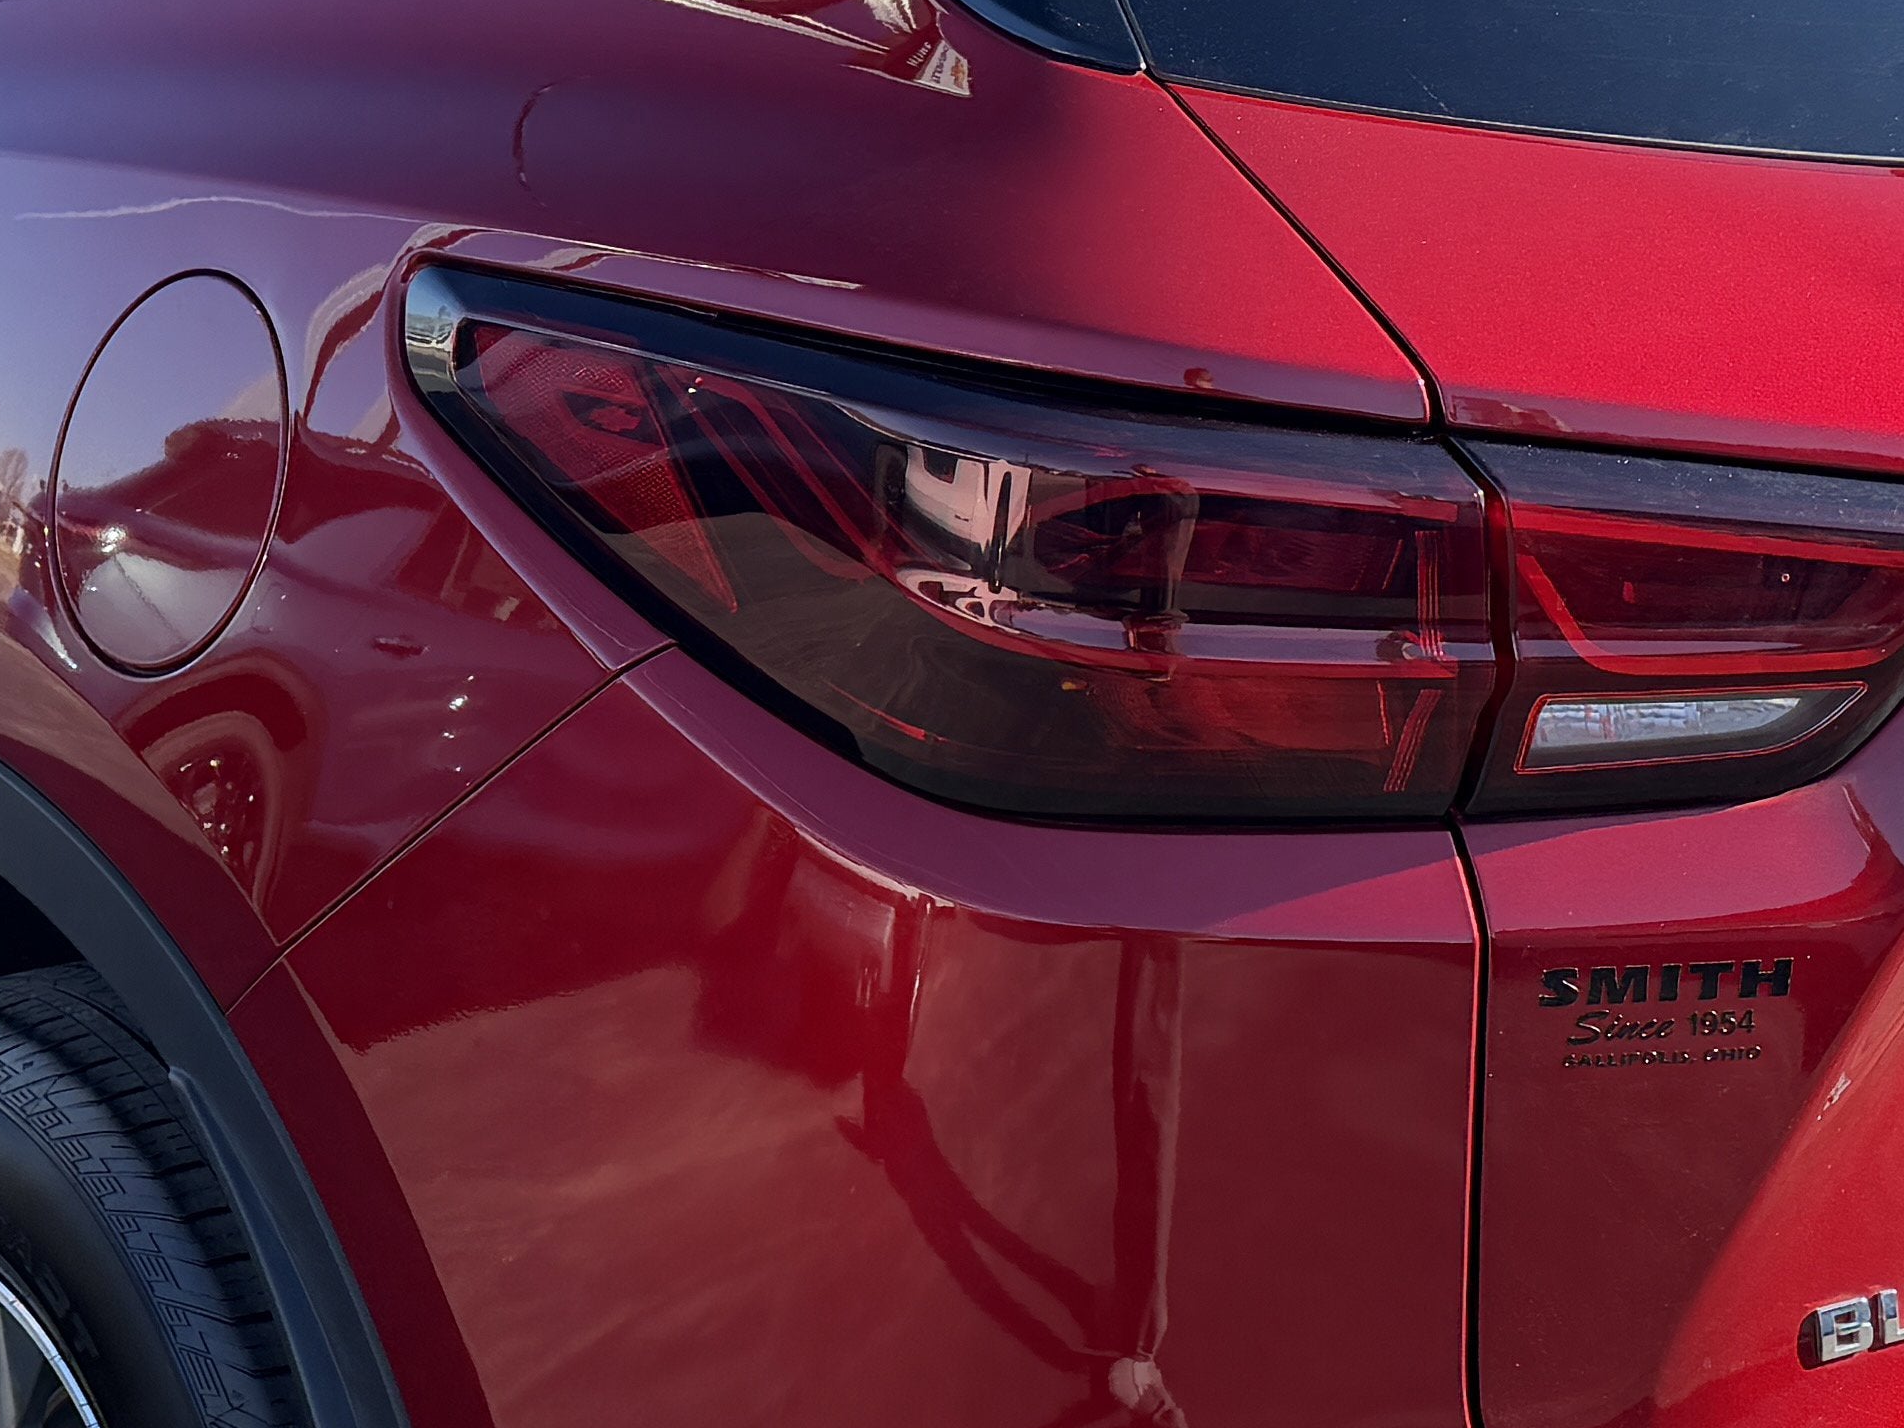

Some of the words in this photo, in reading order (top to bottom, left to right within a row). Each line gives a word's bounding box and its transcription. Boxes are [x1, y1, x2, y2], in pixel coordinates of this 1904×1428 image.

[1538, 957, 1795, 1007] SMITH
[1566, 1009, 1676, 1047] Since
[1689, 1009, 1757, 1036] 1954
[1702, 1044, 1763, 1062] OHIO
